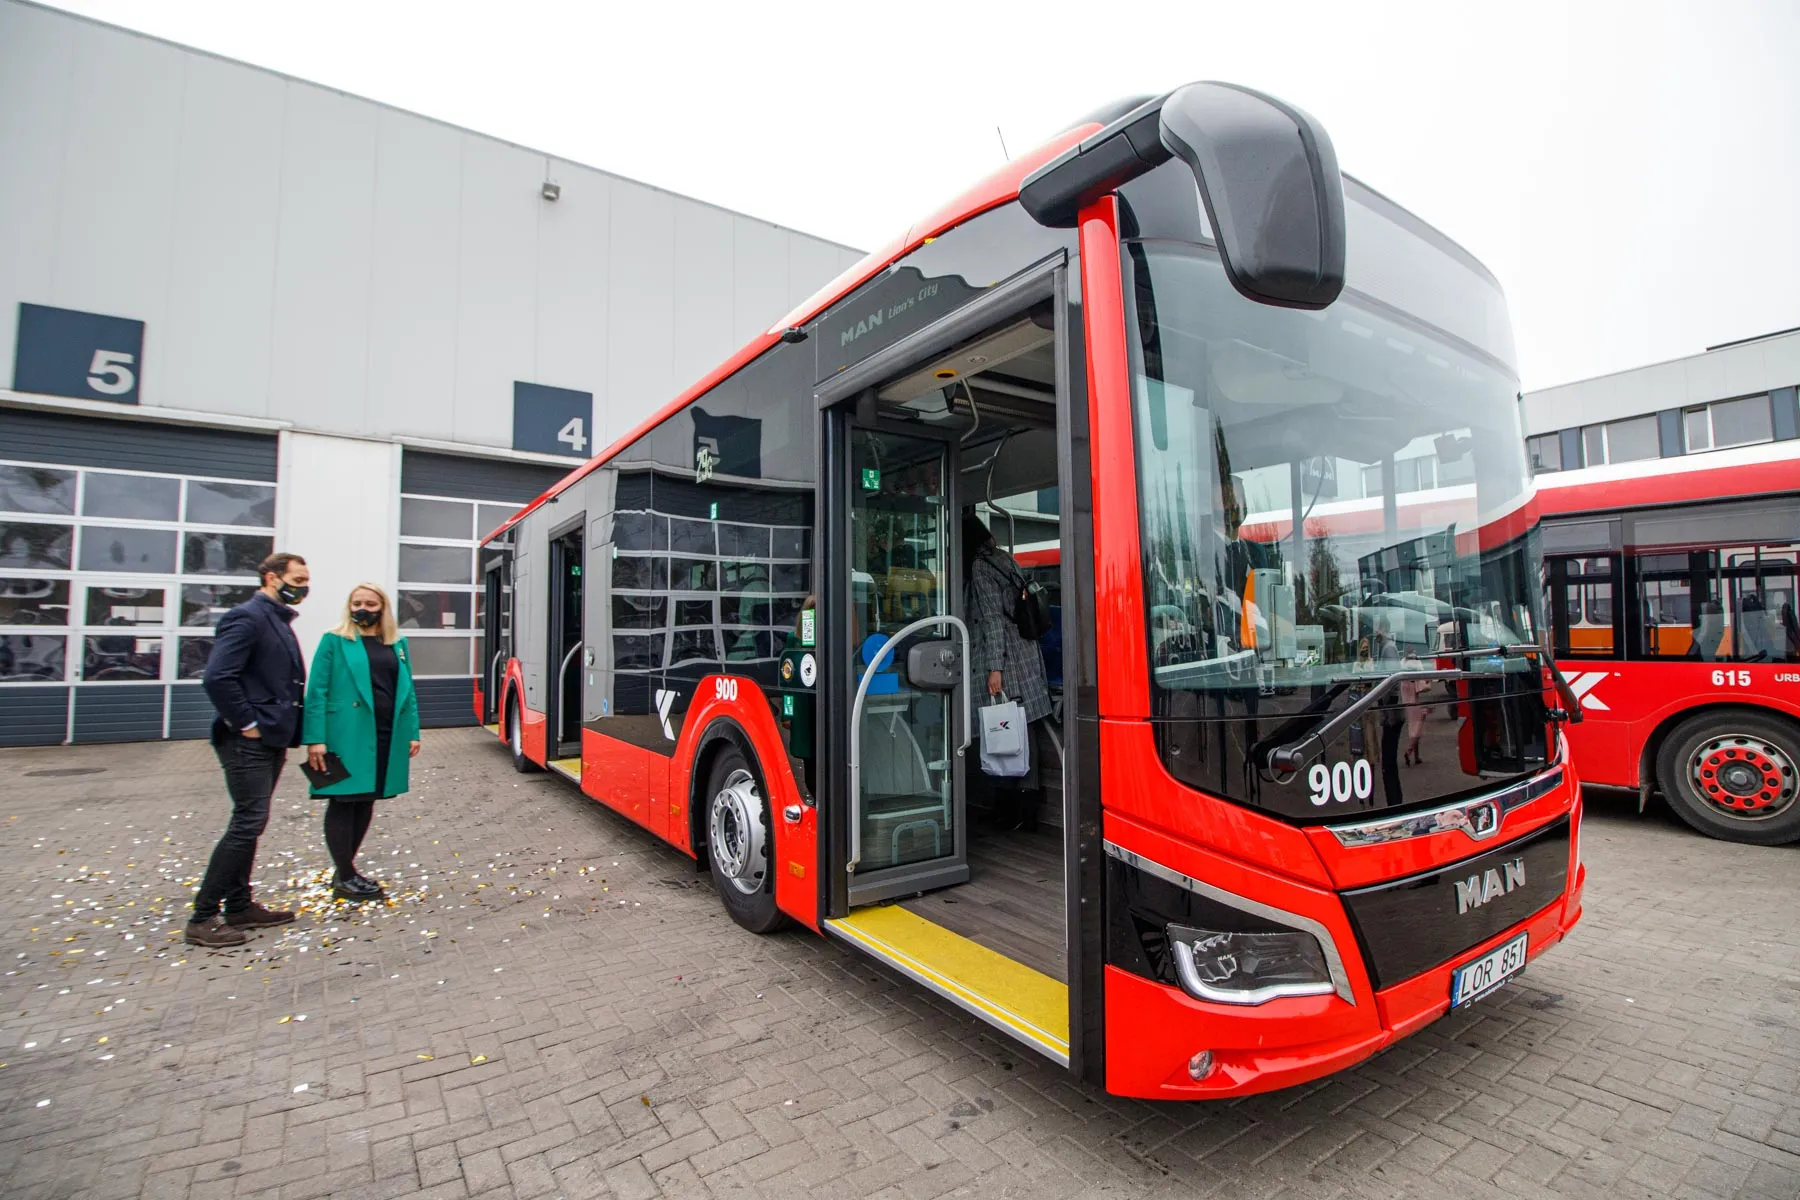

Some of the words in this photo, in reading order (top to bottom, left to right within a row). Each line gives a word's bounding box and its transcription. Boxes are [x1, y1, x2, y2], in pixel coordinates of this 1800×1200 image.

[841, 309, 882, 347] MAN
[888, 296, 914, 319] Lion's
[918, 283, 939, 301] City
[86, 349, 135, 395] 5
[557, 417, 587, 451] 4
[715, 677, 738, 702] 900
[1711, 669, 1752, 687] 615
[1774, 673, 1800, 682] URB
[1308, 758, 1372, 806] 900
[1453, 856, 1526, 915] MAN
[1460, 958, 1493, 999] LOR
[1501, 939, 1524, 975] 851
